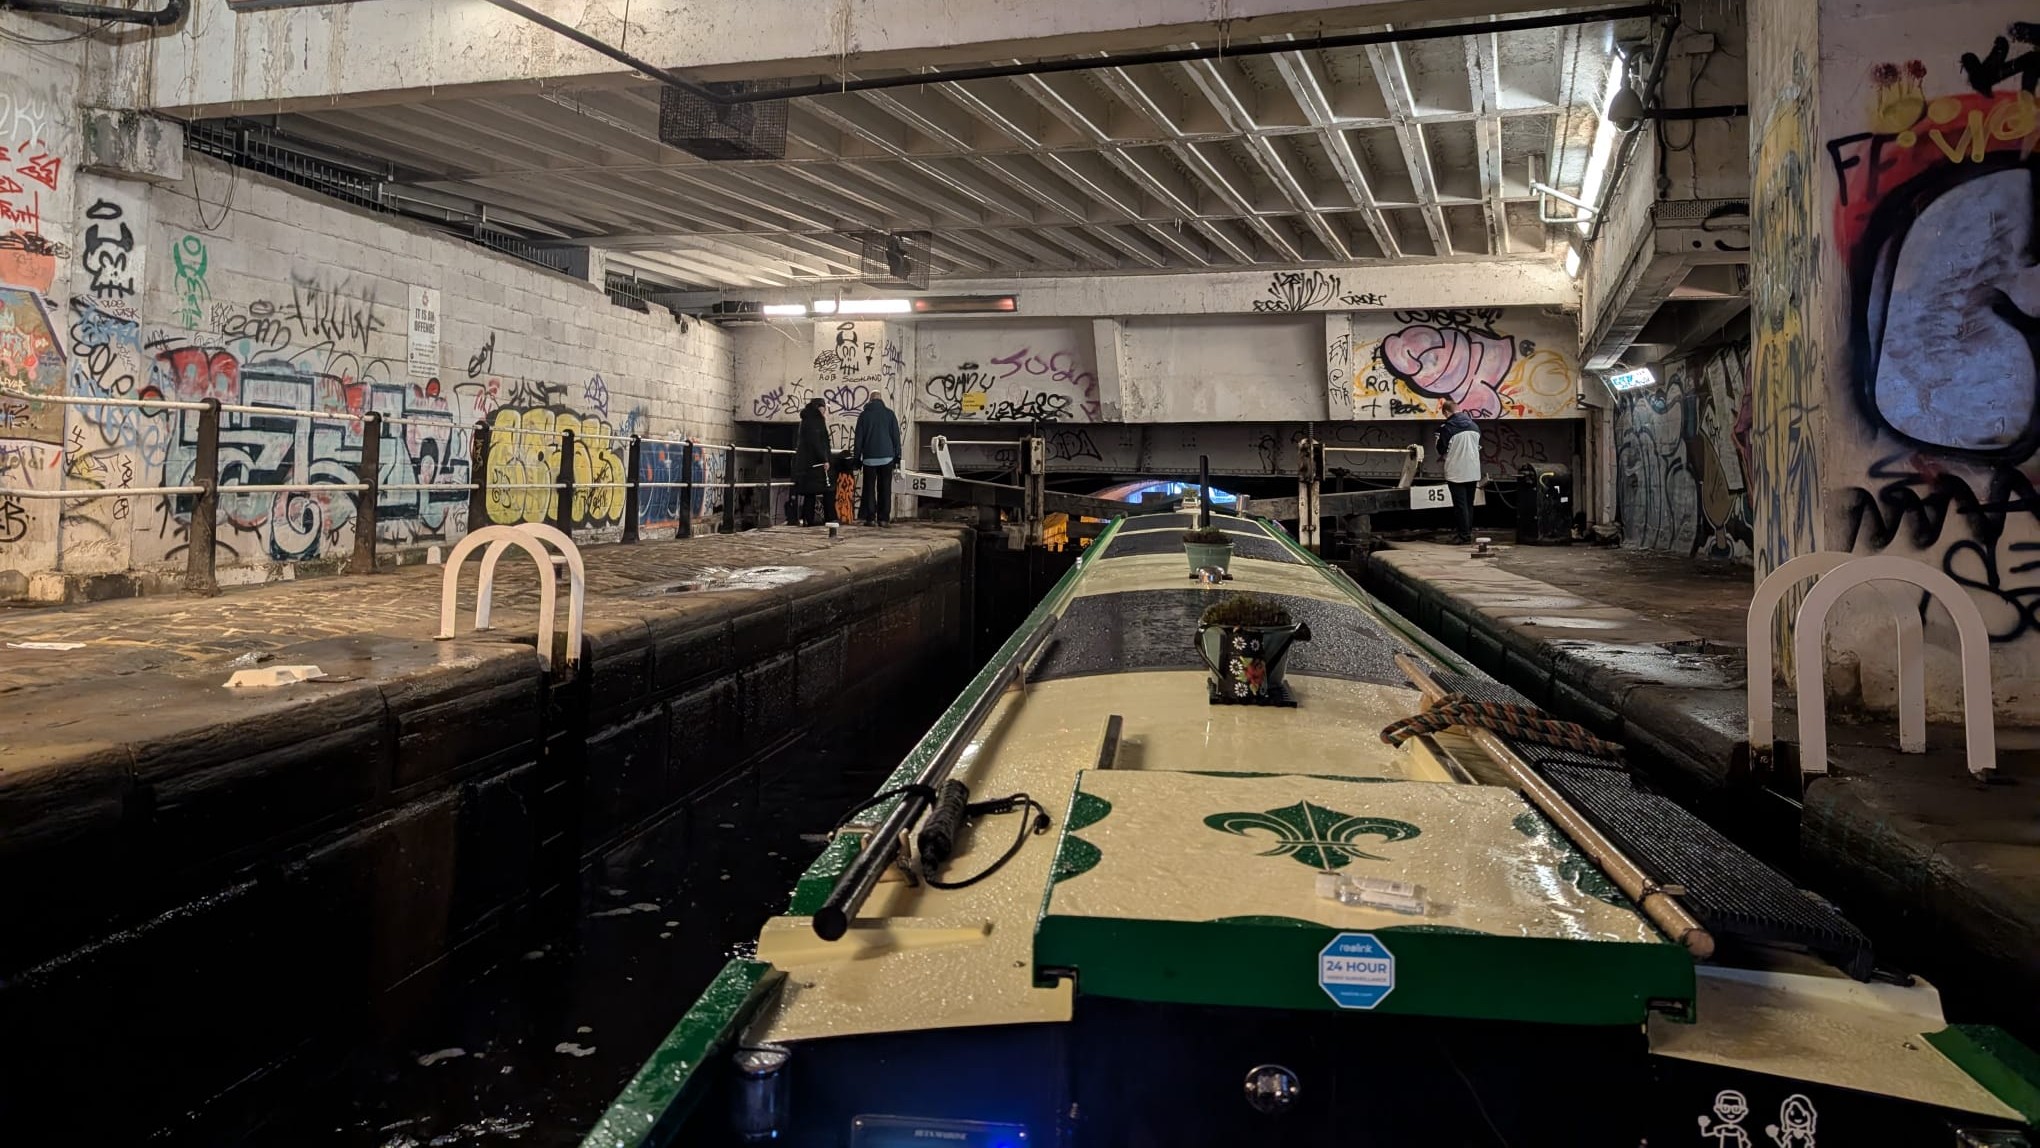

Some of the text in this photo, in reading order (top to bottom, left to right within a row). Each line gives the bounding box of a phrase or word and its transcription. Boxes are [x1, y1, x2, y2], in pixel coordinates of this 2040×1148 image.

[415, 308, 420, 319] IT
[421, 309, 427, 320] IS
[414, 320, 436, 334] OFFENCE
[912, 478, 927, 490] 85
[1428, 489, 1445, 502] 85
[1326, 961, 1387, 973] 24 HOUR
